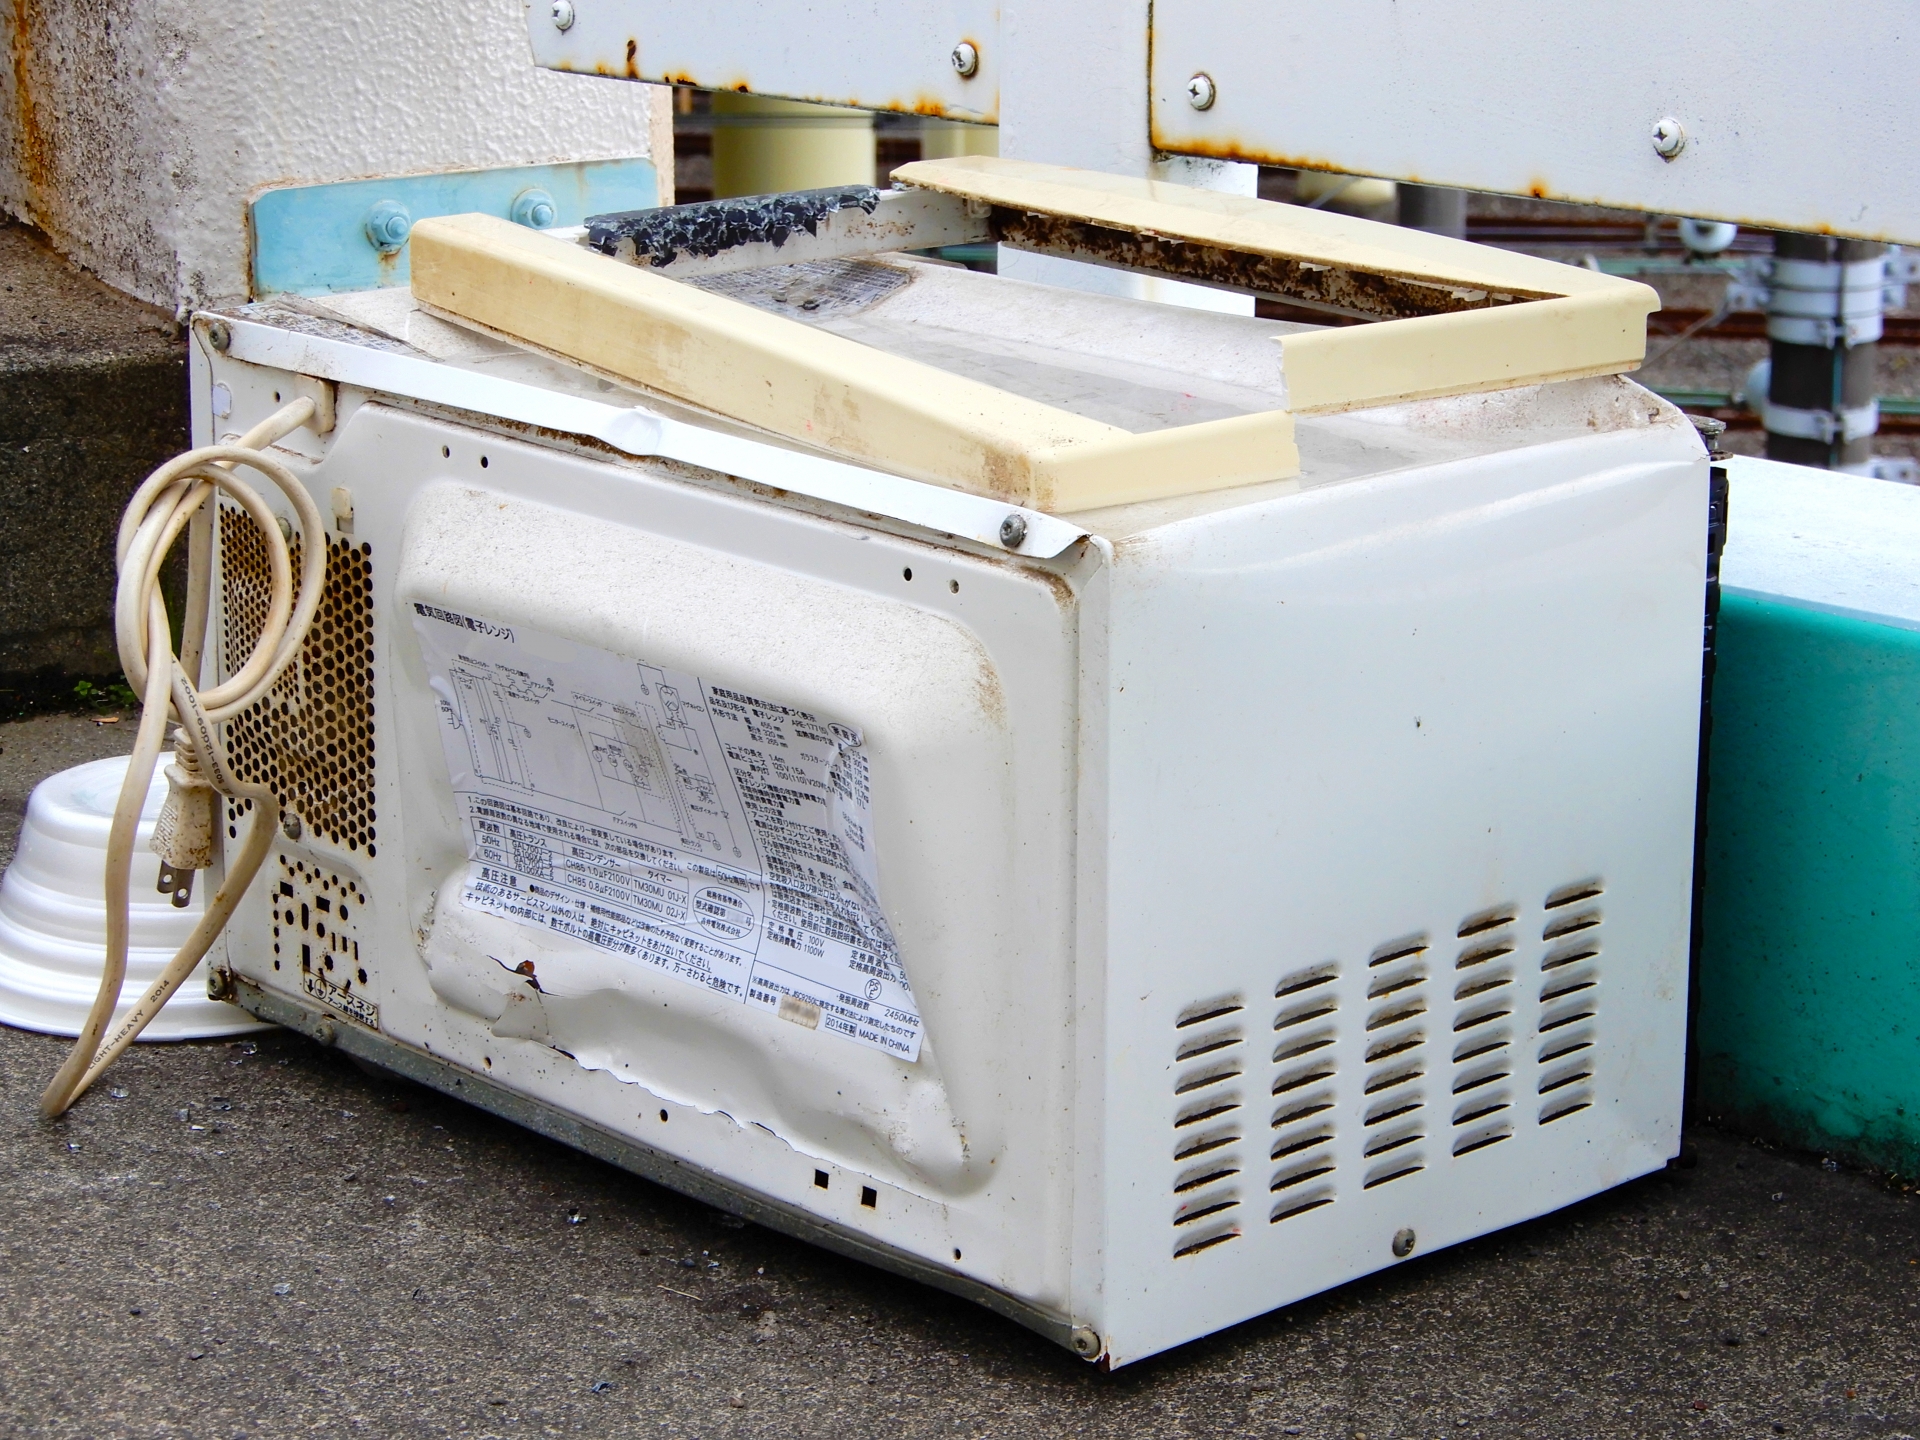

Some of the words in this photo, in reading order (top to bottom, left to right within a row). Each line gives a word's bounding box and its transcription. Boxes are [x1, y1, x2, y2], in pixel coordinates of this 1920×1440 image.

[481, 867, 517, 887] 高圧注意
[89, 1009, 144, 1070] LIGHT-HEAVY
[149, 979, 170, 1003] 2014
[884, 1008, 920, 1027] 2450MHz
[859, 1029, 879, 1043] MADE
[888, 1038, 910, 1054] CHINA
